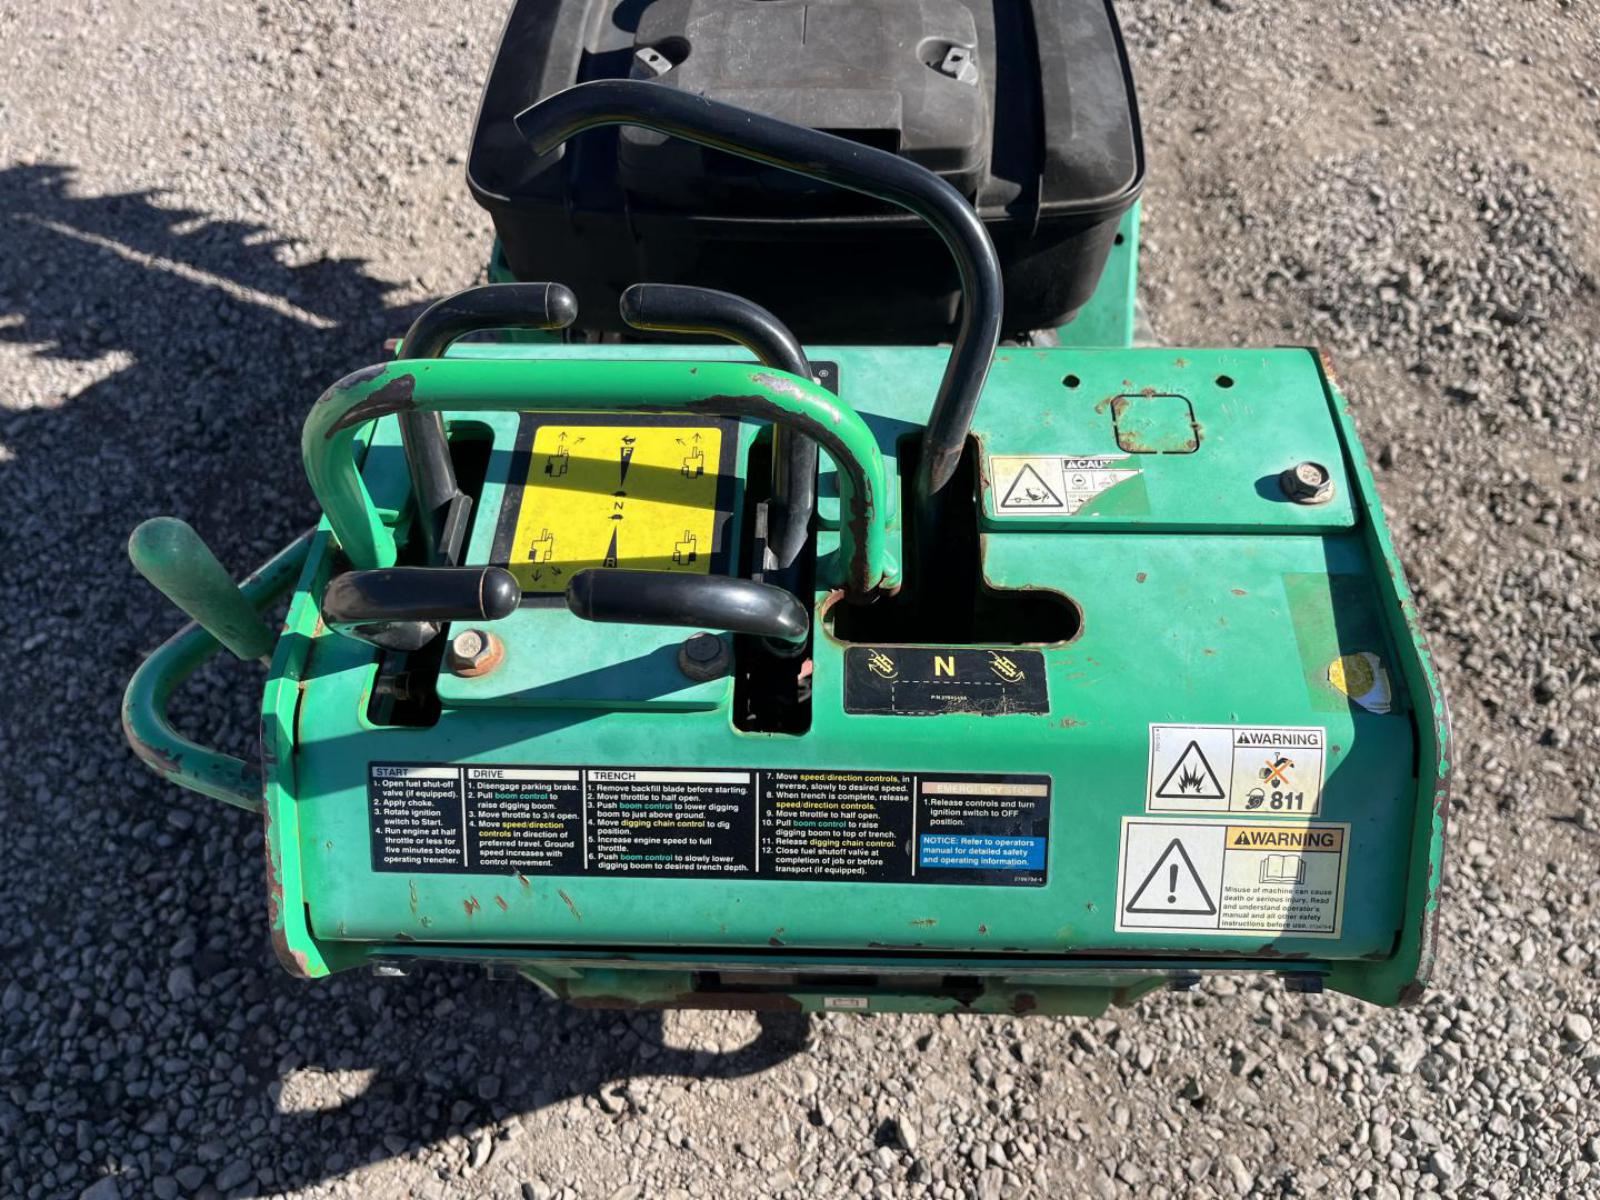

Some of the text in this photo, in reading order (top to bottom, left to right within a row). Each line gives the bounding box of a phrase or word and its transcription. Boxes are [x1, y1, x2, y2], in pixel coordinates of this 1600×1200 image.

[934, 656, 955, 676] N
[1250, 733, 1318, 745] WARNING
[594, 772, 636, 780] TRENCH
[382, 780, 403, 788] Open
[477, 782, 519, 791] Disengage
[522, 783, 551, 791] parking
[811, 784, 836, 792] slowly
[881, 785, 908, 793] speed.
[405, 791, 413, 799] (if
[415, 791, 458, 800] equipped).
[715, 787, 748, 795] starting.
[838, 793, 877, 802] complete,
[1270, 791, 1304, 810] 811
[383, 799, 406, 808] Apply
[499, 803, 529, 811] digging
[708, 804, 739, 812] digging
[411, 809, 441, 818] ignition
[931, 809, 960, 817] ignition
[930, 819, 965, 827] position.
[598, 828, 631, 836] position.
[810, 839, 839, 847] digging
[995, 838, 1035, 847] operators
[1251, 832, 1334, 846] WARNING
[480, 840, 516, 848] preferred
[480, 850, 504, 858] speed
[1003, 848, 1028, 856] safety
[384, 856, 421, 865] operating
[941, 857, 978, 865] operating
[598, 862, 628, 871] digging
[724, 864, 749, 873] depth.
[776, 866, 867, 875] transport (if equipped).
